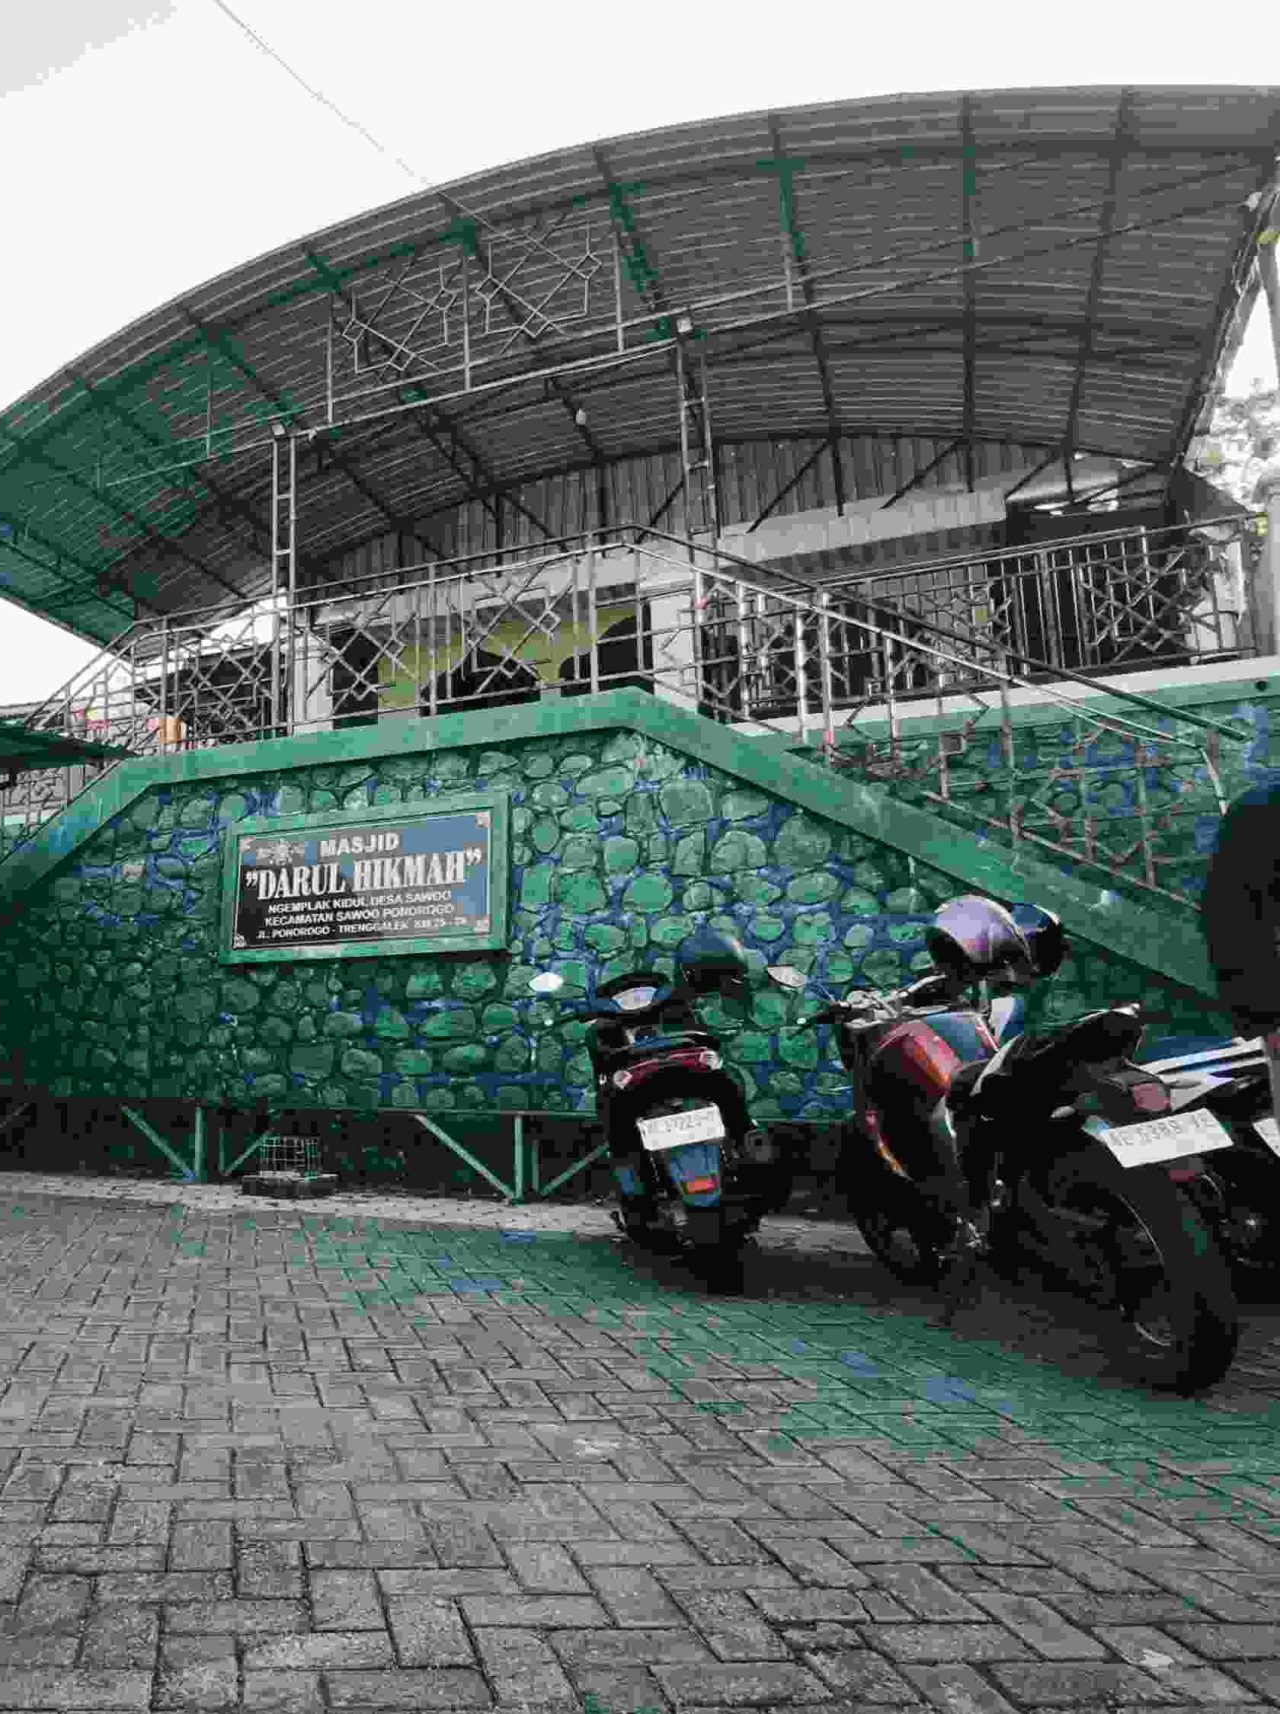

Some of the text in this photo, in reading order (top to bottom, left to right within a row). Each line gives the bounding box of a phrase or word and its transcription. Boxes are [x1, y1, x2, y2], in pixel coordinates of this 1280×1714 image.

[320, 832, 401, 857] MASJID
[268, 900, 330, 914] NGEMPLAK
[333, 896, 368, 909] KIDUL
[371, 893, 402, 906] DESA
[265, 903, 453, 927] KECAMATAN SAWOO PONOROGO
[272, 925, 331, 938] PONOROGO
